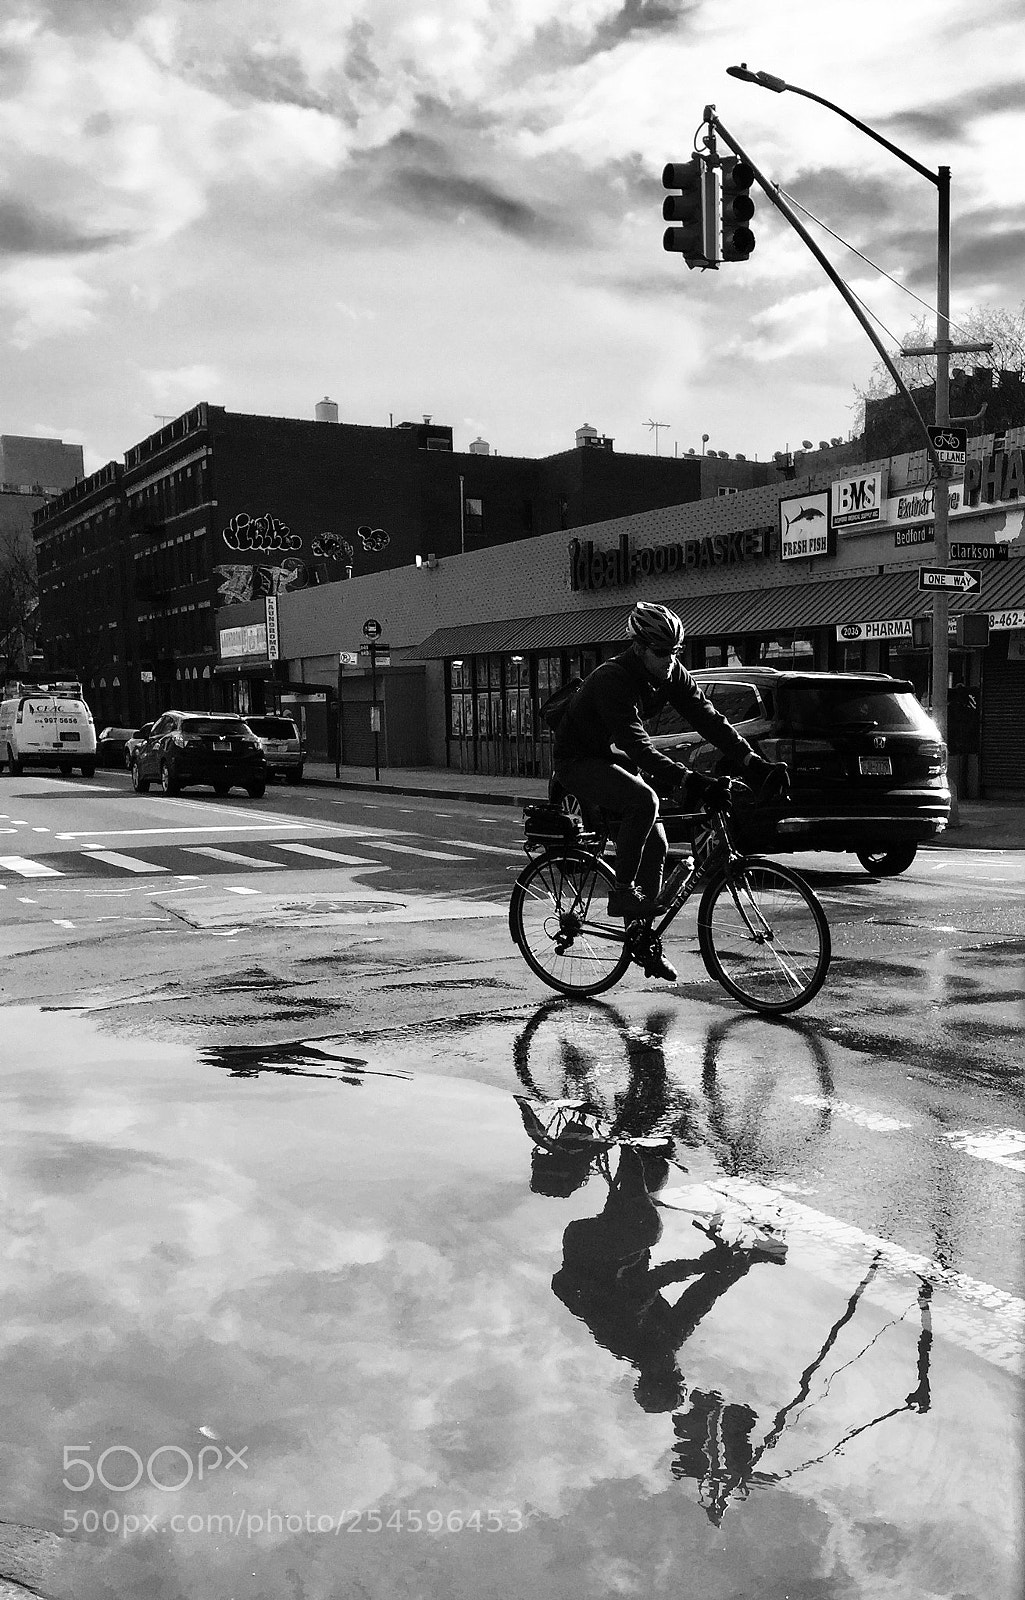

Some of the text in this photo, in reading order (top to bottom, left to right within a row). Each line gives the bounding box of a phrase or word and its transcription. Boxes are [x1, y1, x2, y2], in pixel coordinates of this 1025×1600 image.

[947, 452, 965, 463] LANE
[838, 478, 876, 514] BMS
[896, 526, 926, 545] Bedford
[629, 544, 684, 576] FOOD
[685, 526, 775, 569] BASKET
[783, 536, 827, 557] FRESH FISH
[951, 544, 995, 559] Clarkson
[928, 574, 972, 587] ONE WAY
[268, 598, 277, 658] LAUNDROMAT
[843, 621, 912, 637] 2036 PHARMA
